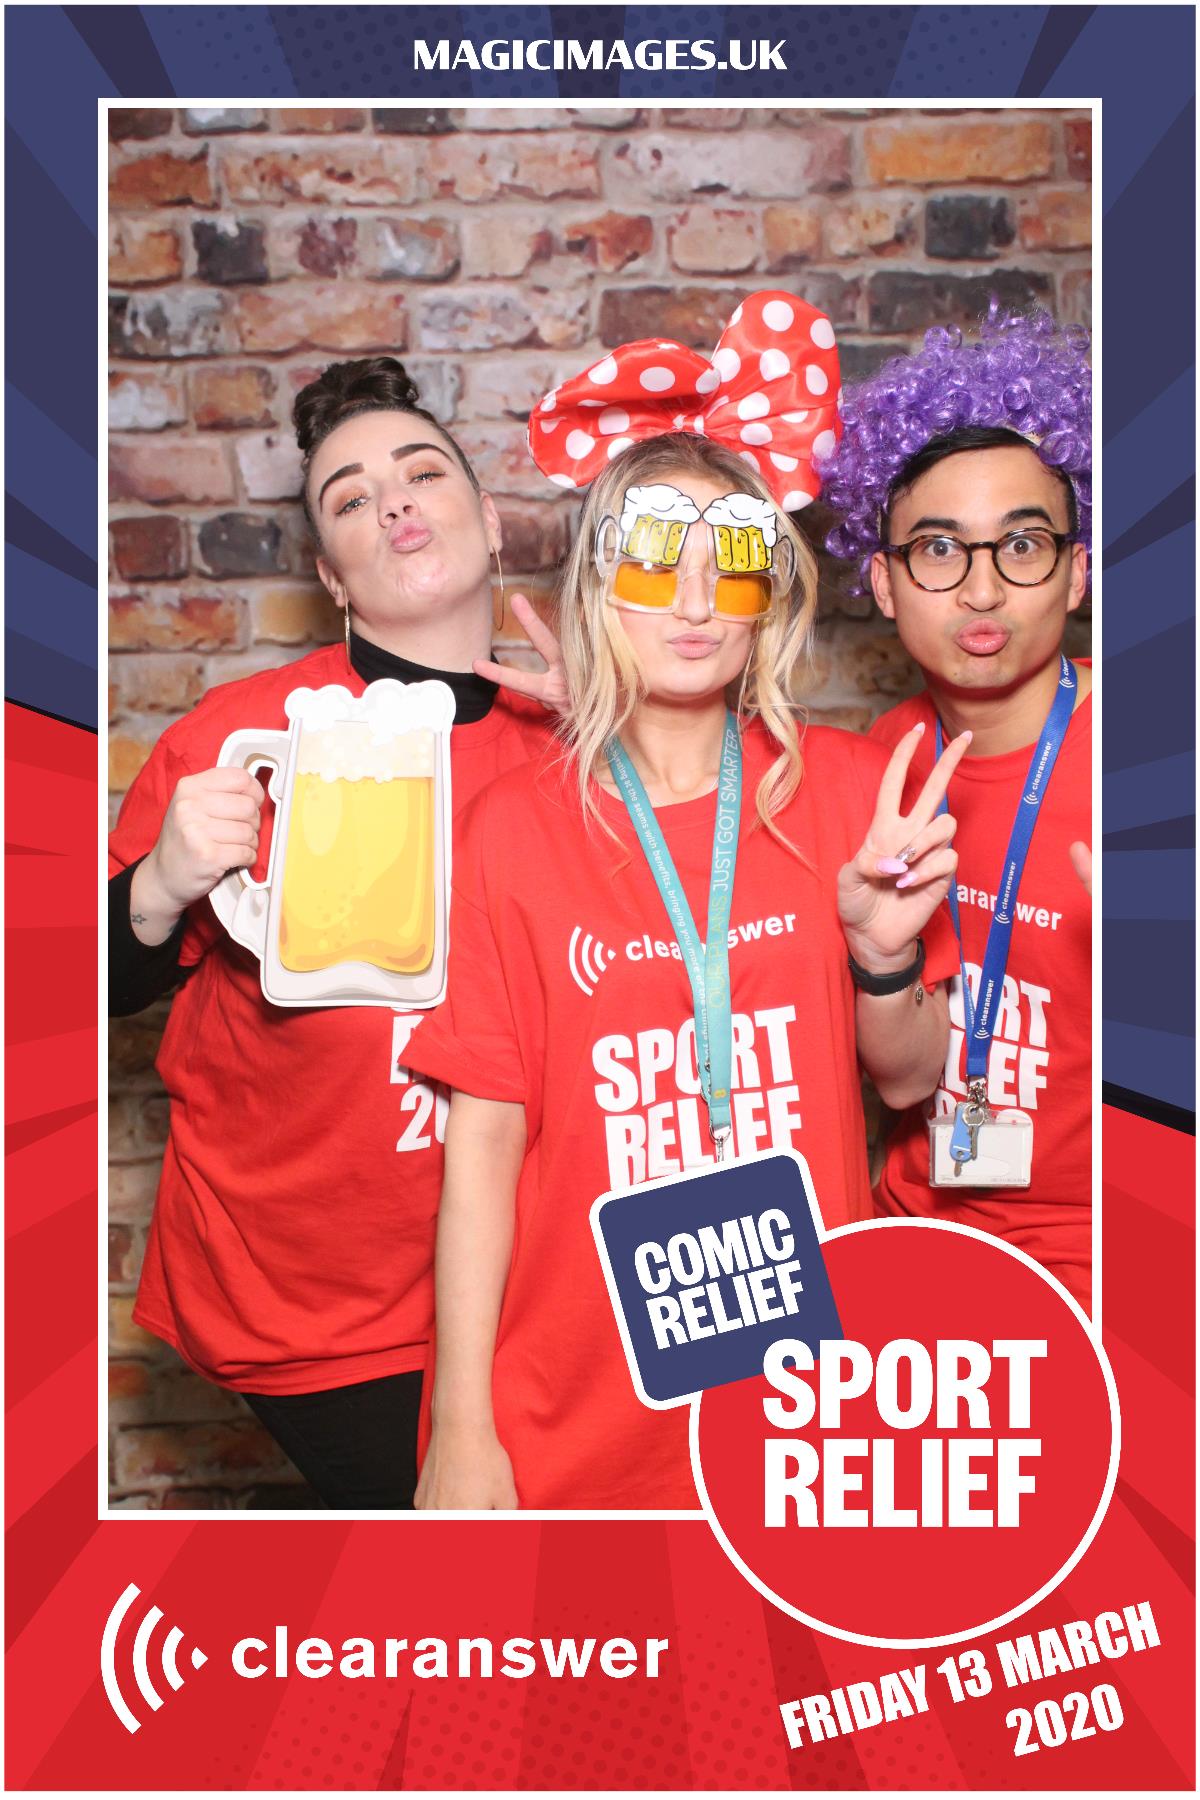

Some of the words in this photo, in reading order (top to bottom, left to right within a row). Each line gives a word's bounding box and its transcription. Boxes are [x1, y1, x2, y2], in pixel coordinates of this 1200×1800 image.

[721, 728, 738, 802] SMARTER
[1032, 741, 1052, 790] clearanswer
[718, 807, 736, 844] GOT
[634, 803, 649, 830] seams
[645, 830, 657, 849] with
[653, 849, 671, 889] benefits,
[667, 889, 686, 927] bringing
[680, 929, 692, 946] you
[687, 948, 700, 972] more
[713, 849, 731, 892] JUST
[1002, 861, 1017, 910] clearanswer
[625, 913, 797, 961] cleaswer
[709, 895, 728, 958] PLANS
[947, 962, 1052, 1048] ORT
[981, 979, 995, 1026] clearanswer
[591, 1004, 797, 1113] SPORT
